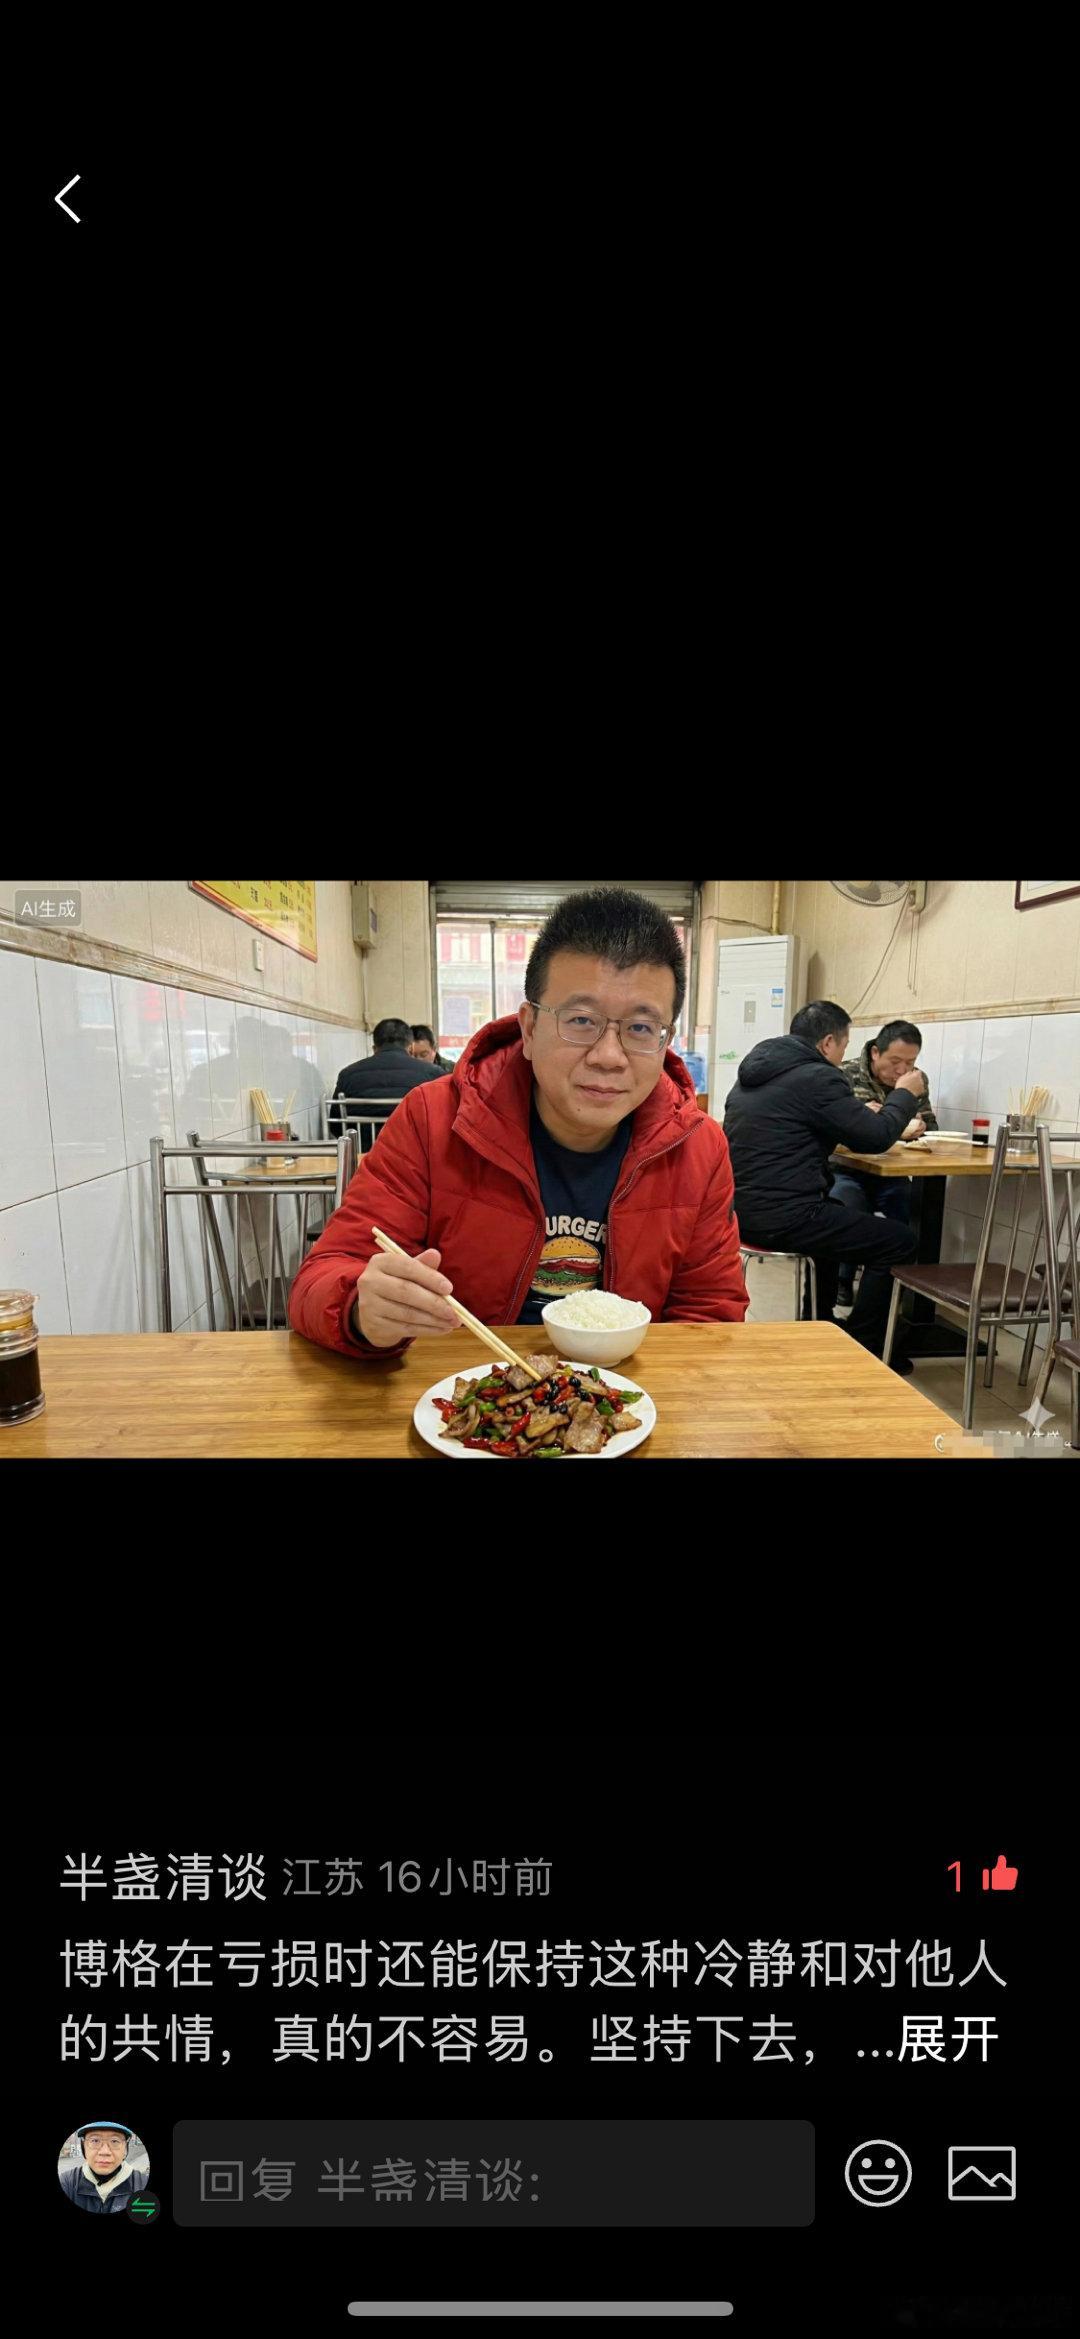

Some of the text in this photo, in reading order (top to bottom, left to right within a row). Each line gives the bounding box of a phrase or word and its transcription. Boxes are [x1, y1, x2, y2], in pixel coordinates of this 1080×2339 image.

[60, 1852, 267, 1902] 半盏清谈
[282, 1857, 364, 1897] 江苏
[947, 1860, 961, 1893] 1
[60, 1938, 1008, 1989] 博格在亏损时还能保持这种冷静和对他人
[200, 2157, 297, 2202] 回复
